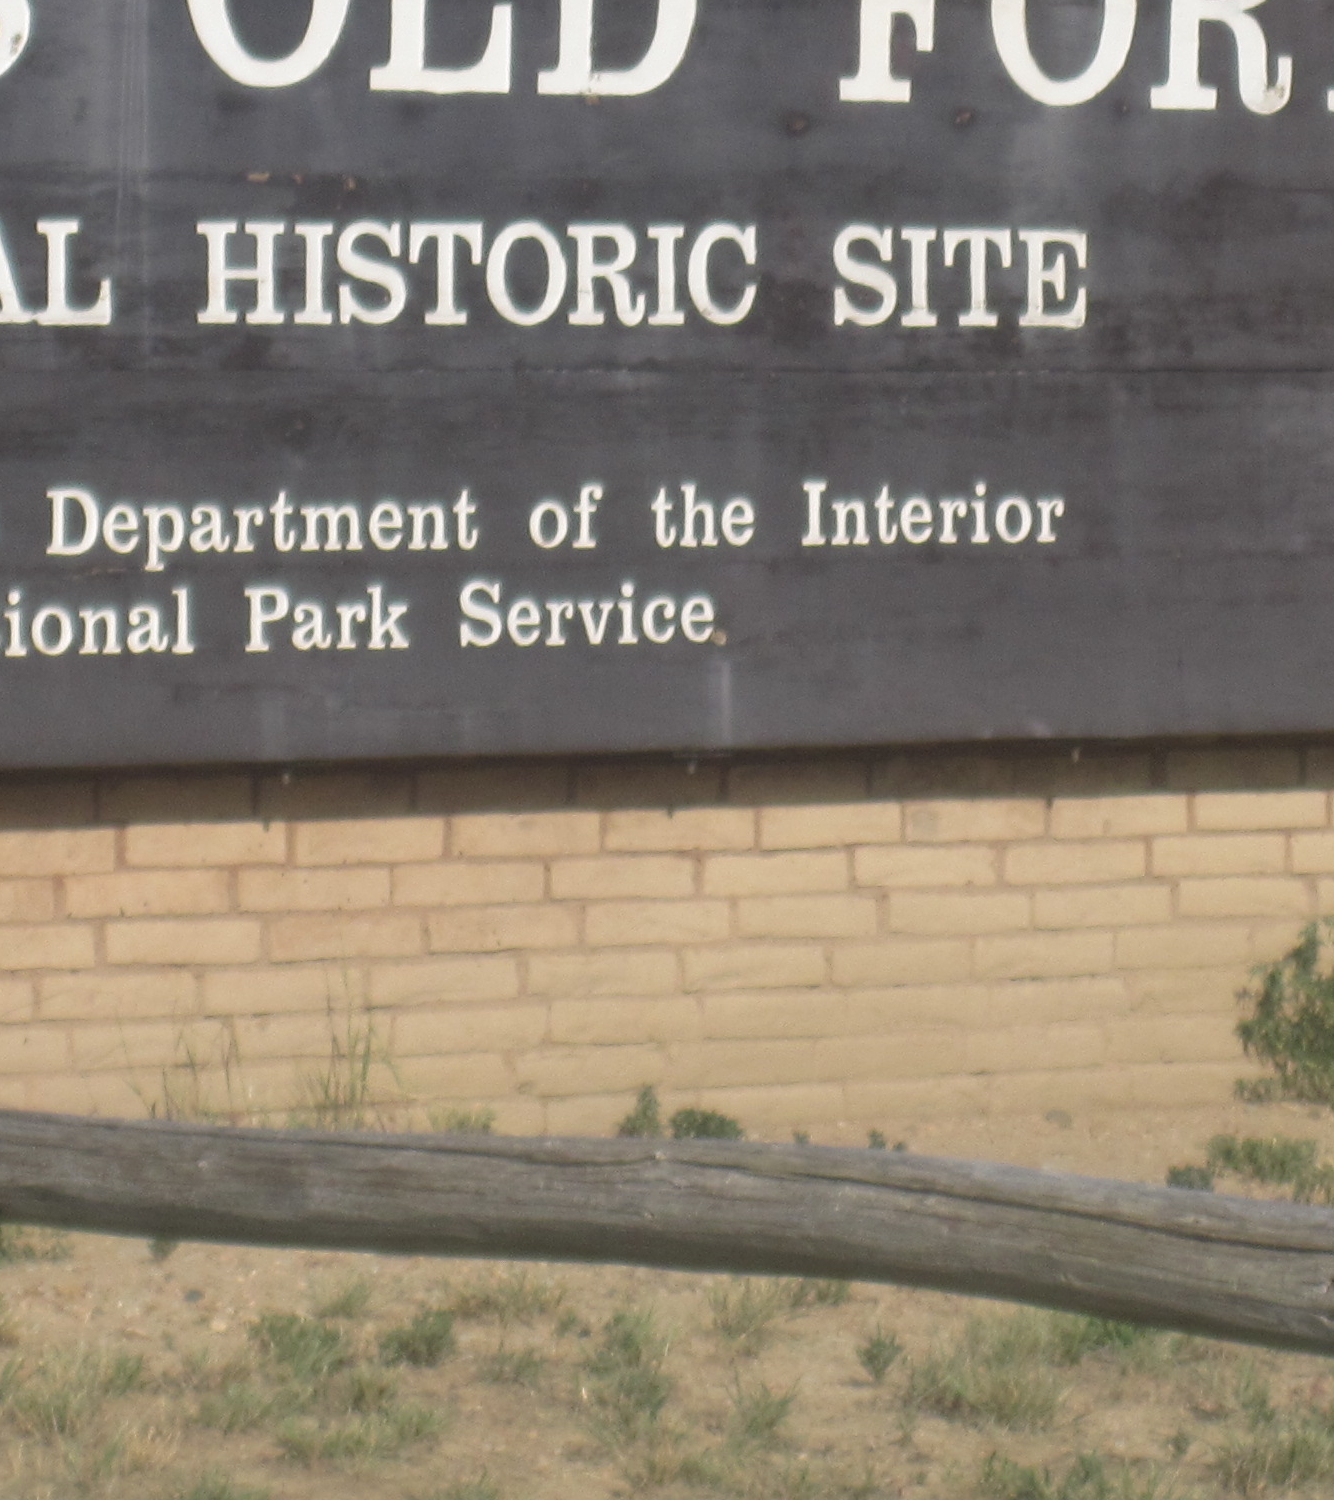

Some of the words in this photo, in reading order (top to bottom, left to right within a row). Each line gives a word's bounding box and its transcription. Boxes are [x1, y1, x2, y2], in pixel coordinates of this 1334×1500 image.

[197, 220, 757, 326] HISTORIC
[833, 225, 1087, 329] SITE
[47, 487, 478, 571] Department
[530, 483, 603, 548] of
[651, 483, 754, 547] the
[802, 481, 1064, 546] Interior
[245, 585, 409, 651] Park
[460, 580, 714, 647] Service
